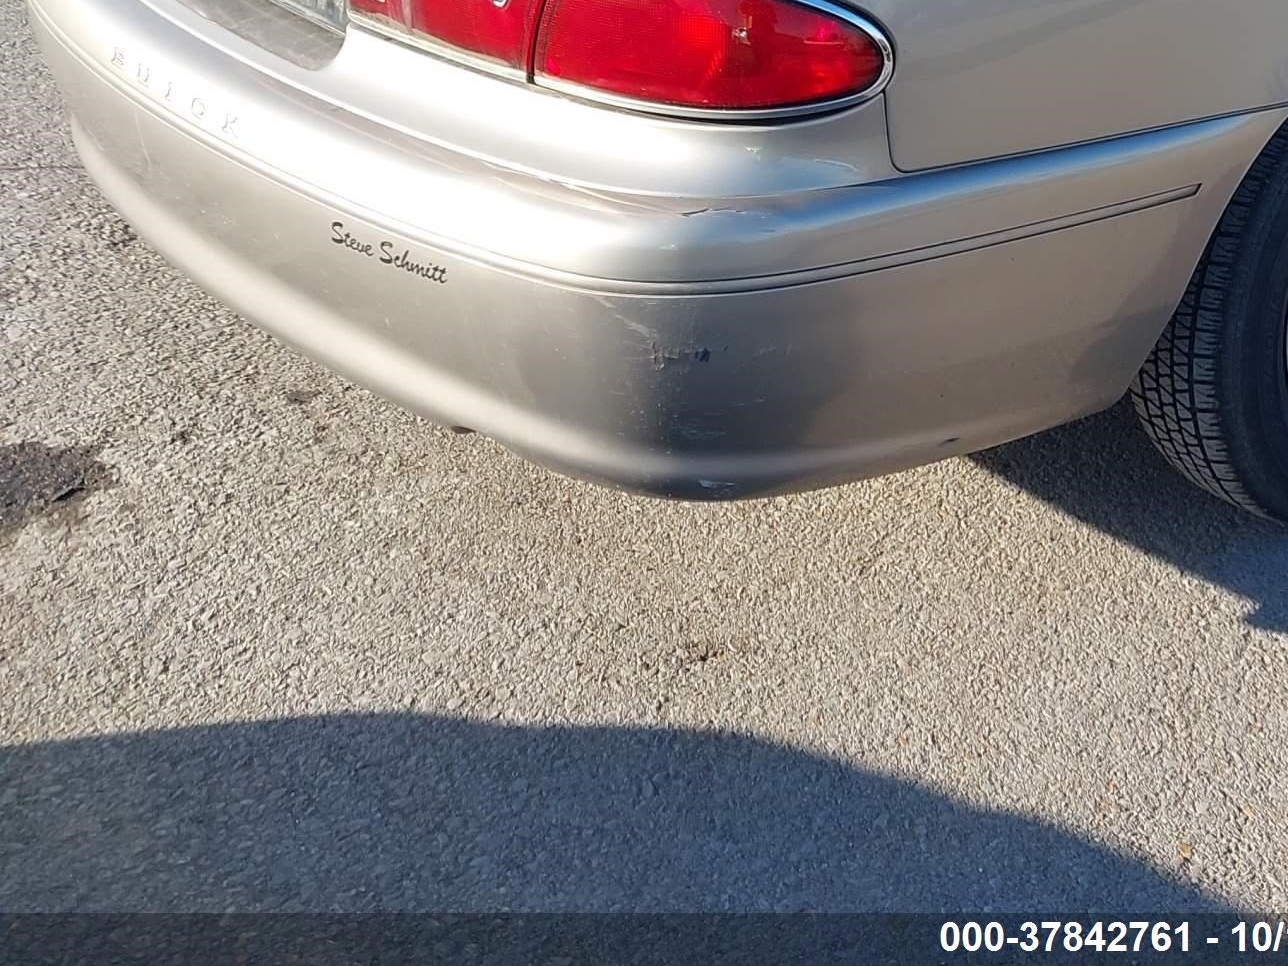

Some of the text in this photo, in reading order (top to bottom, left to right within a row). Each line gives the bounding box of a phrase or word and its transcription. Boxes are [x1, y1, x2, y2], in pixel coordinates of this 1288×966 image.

[111, 47, 238, 138] BUICK
[331, 221, 448, 284] Steve Schmitt
